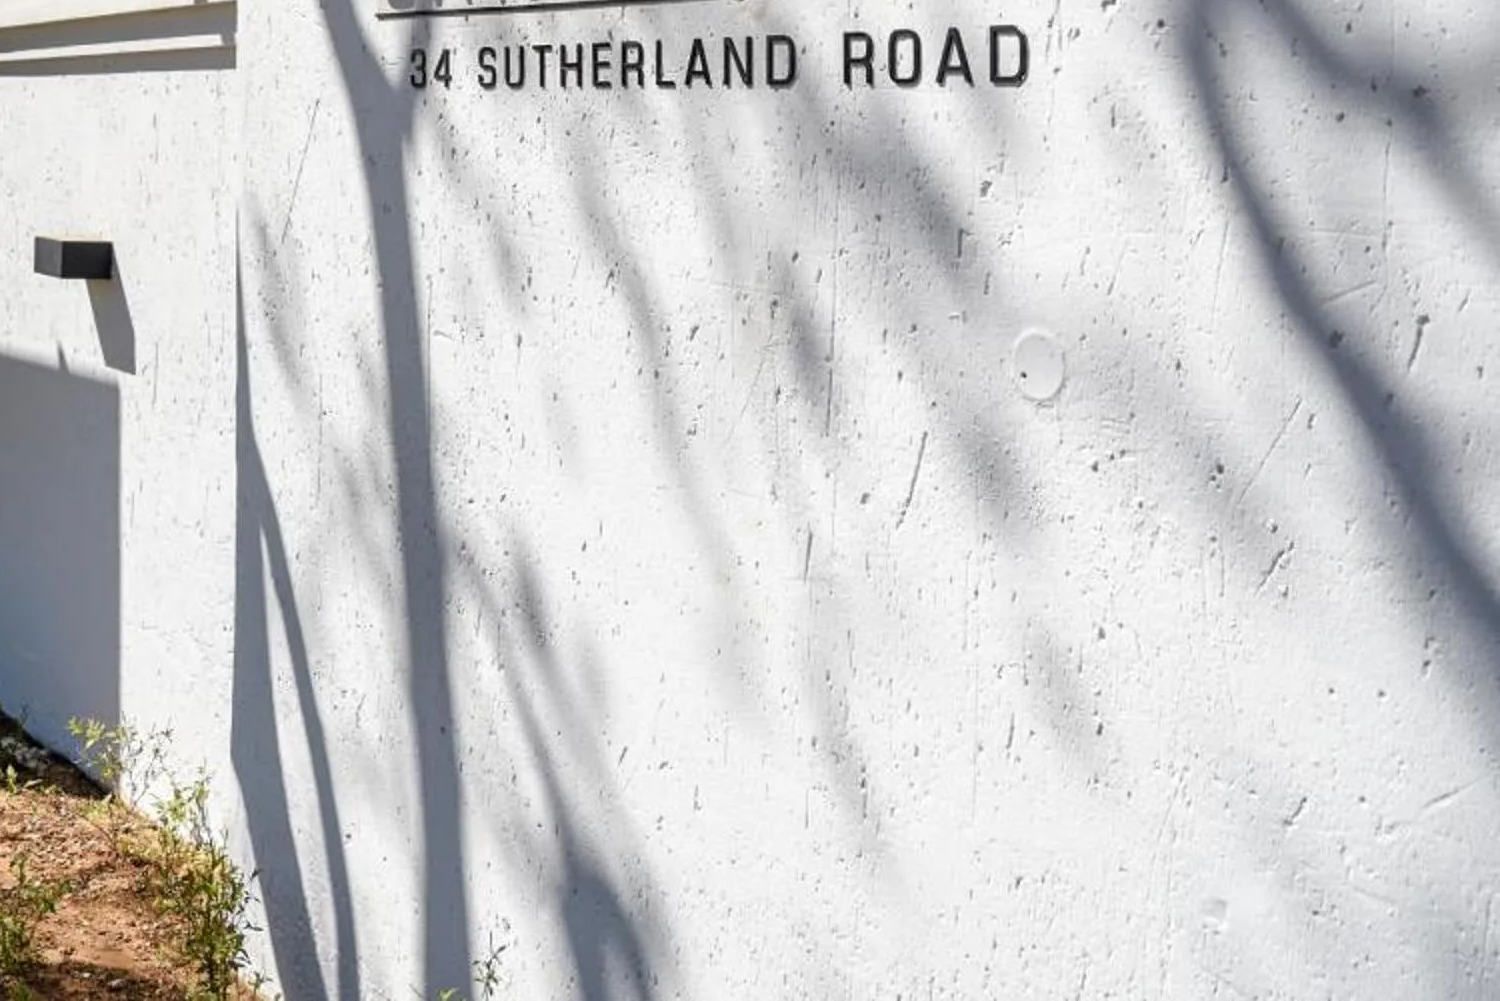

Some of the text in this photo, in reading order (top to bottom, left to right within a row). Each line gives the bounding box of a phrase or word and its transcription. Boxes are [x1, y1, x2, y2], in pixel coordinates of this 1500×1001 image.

[408, 23, 1031, 92] 34 SUTHERLAND ROAD
